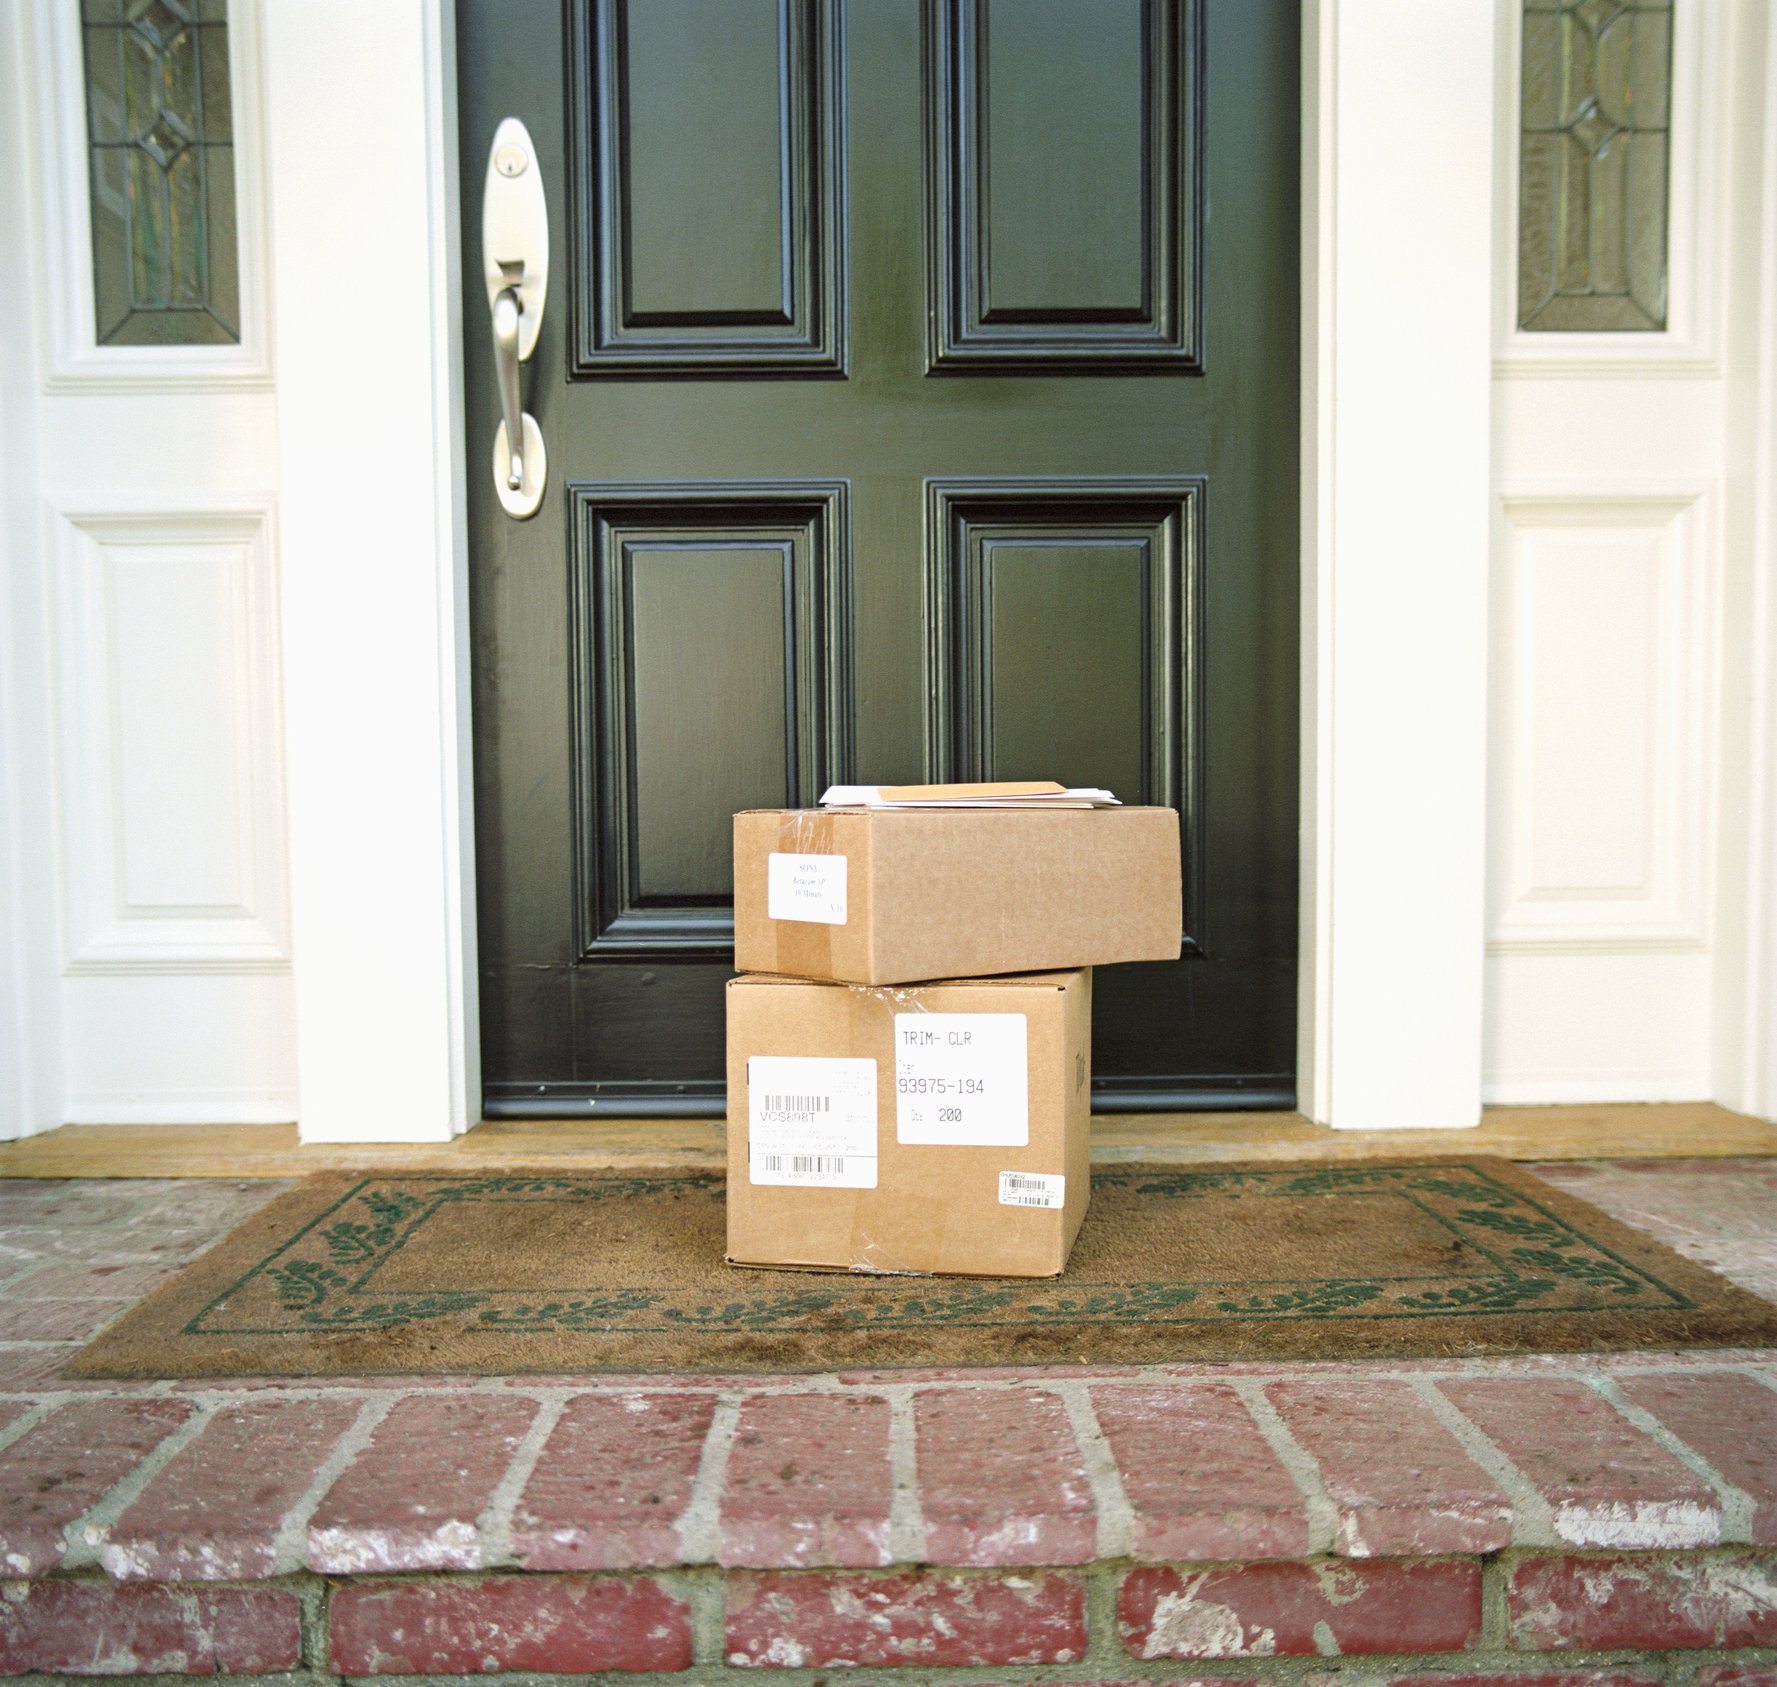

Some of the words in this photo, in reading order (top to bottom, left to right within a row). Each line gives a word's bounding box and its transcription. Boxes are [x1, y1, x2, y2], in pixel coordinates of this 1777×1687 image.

[903, 1031, 941, 1046] TRIM-
[948, 1031, 972, 1046] CLR
[898, 1078, 984, 1094] 93975-194
[759, 1111, 817, 1123] VCS898T
[939, 1108, 962, 1122] 200
